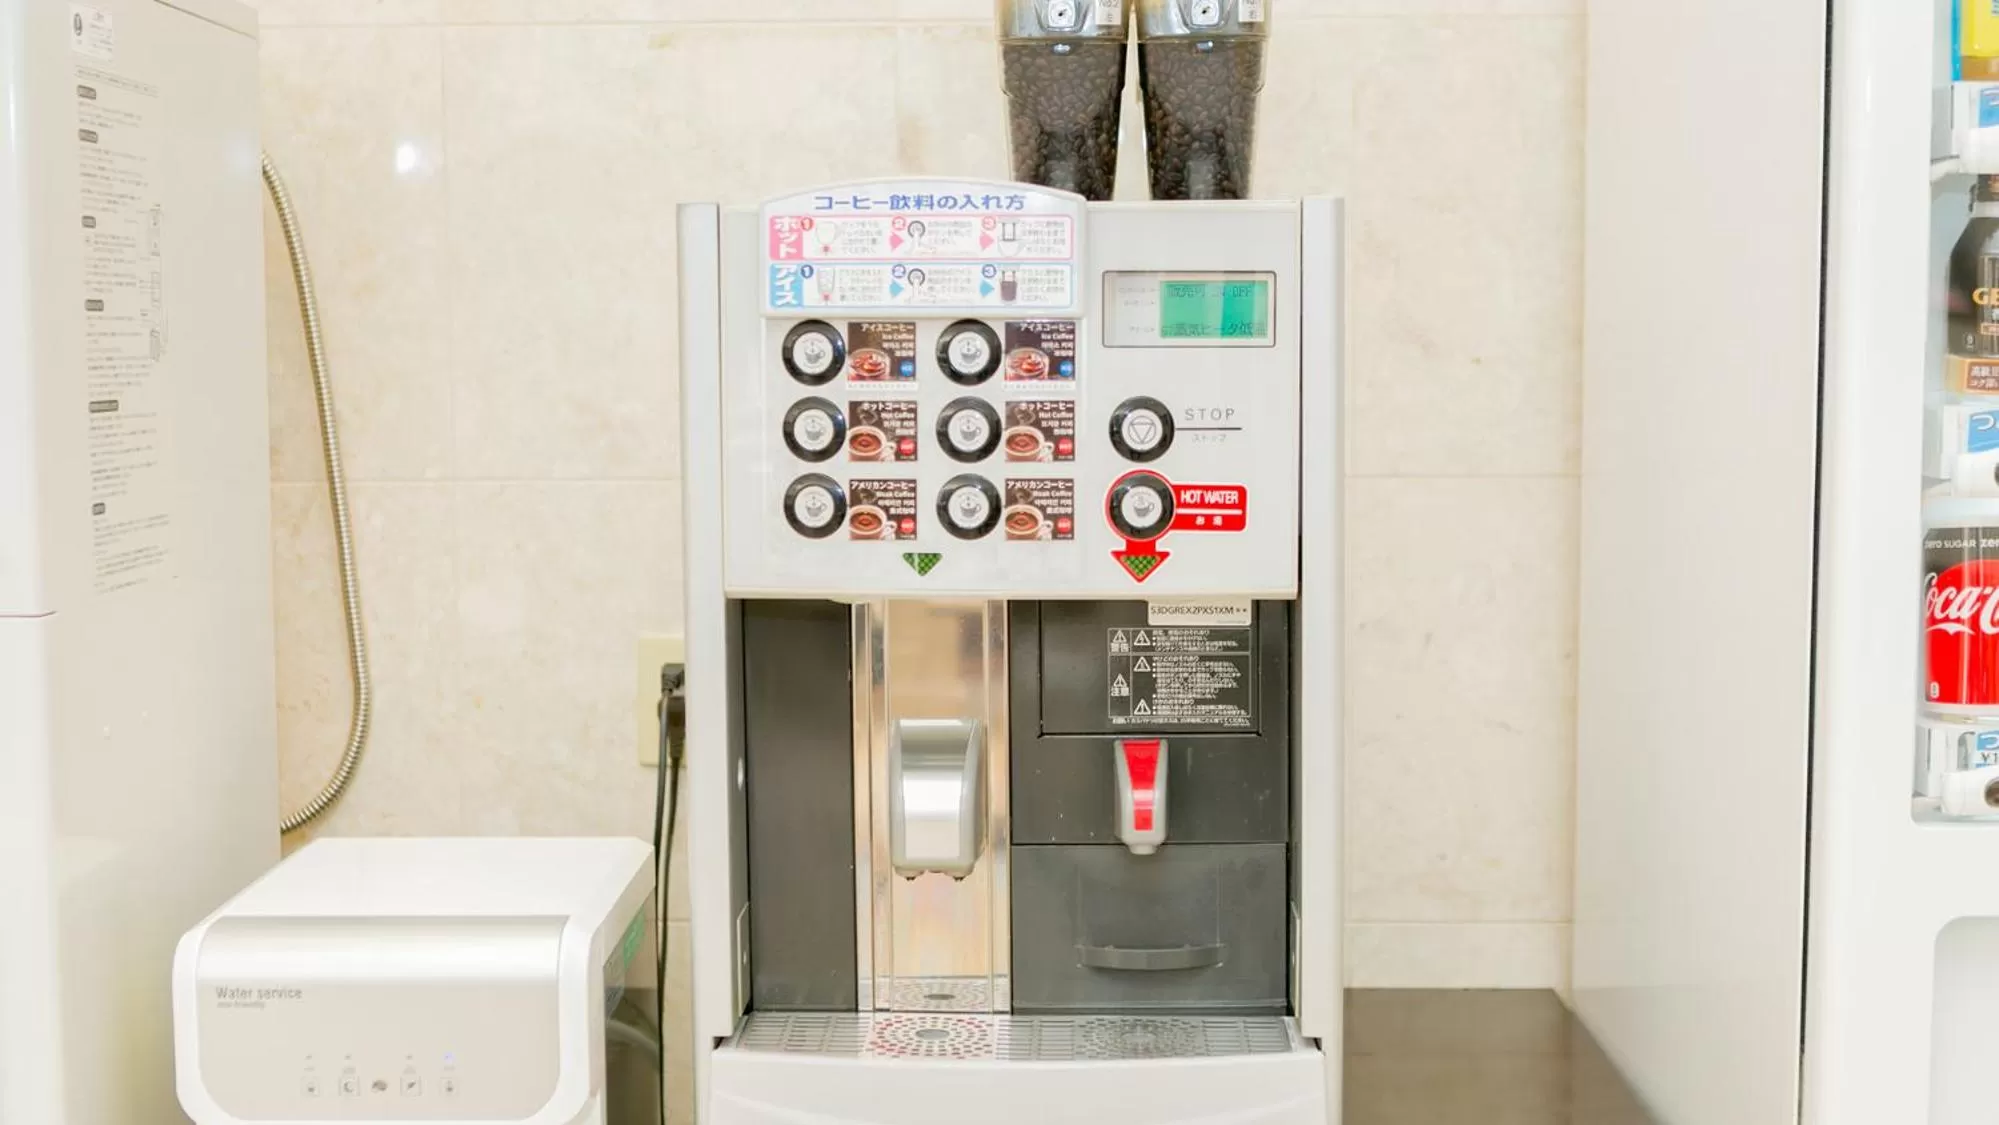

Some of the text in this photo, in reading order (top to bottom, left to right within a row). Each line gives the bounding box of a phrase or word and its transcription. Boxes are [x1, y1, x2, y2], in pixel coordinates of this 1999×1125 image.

[814, 194, 1026, 211] コーヒー飲料の入れ方
[773, 216, 798, 258] ホット
[775, 264, 798, 305] アイス
[861, 323, 915, 331] アイスコーヒー
[1020, 323, 1074, 331] アイスコーヒー
[862, 402, 916, 410] ホットコーヒー
[1019, 402, 1073, 410] ホットコーヒー
[894, 411, 914, 419] Coffee
[1052, 411, 1073, 419] Coffee
[1184, 407, 1236, 422] STOP
[851, 481, 915, 489] アメリカンコーヒー
[1007, 481, 1072, 489] アメリカンコーヒー
[1180, 489, 1239, 505] HOT WATER
[1944, 539, 1977, 549] SUGAR
[215, 986, 302, 1000] Water service
